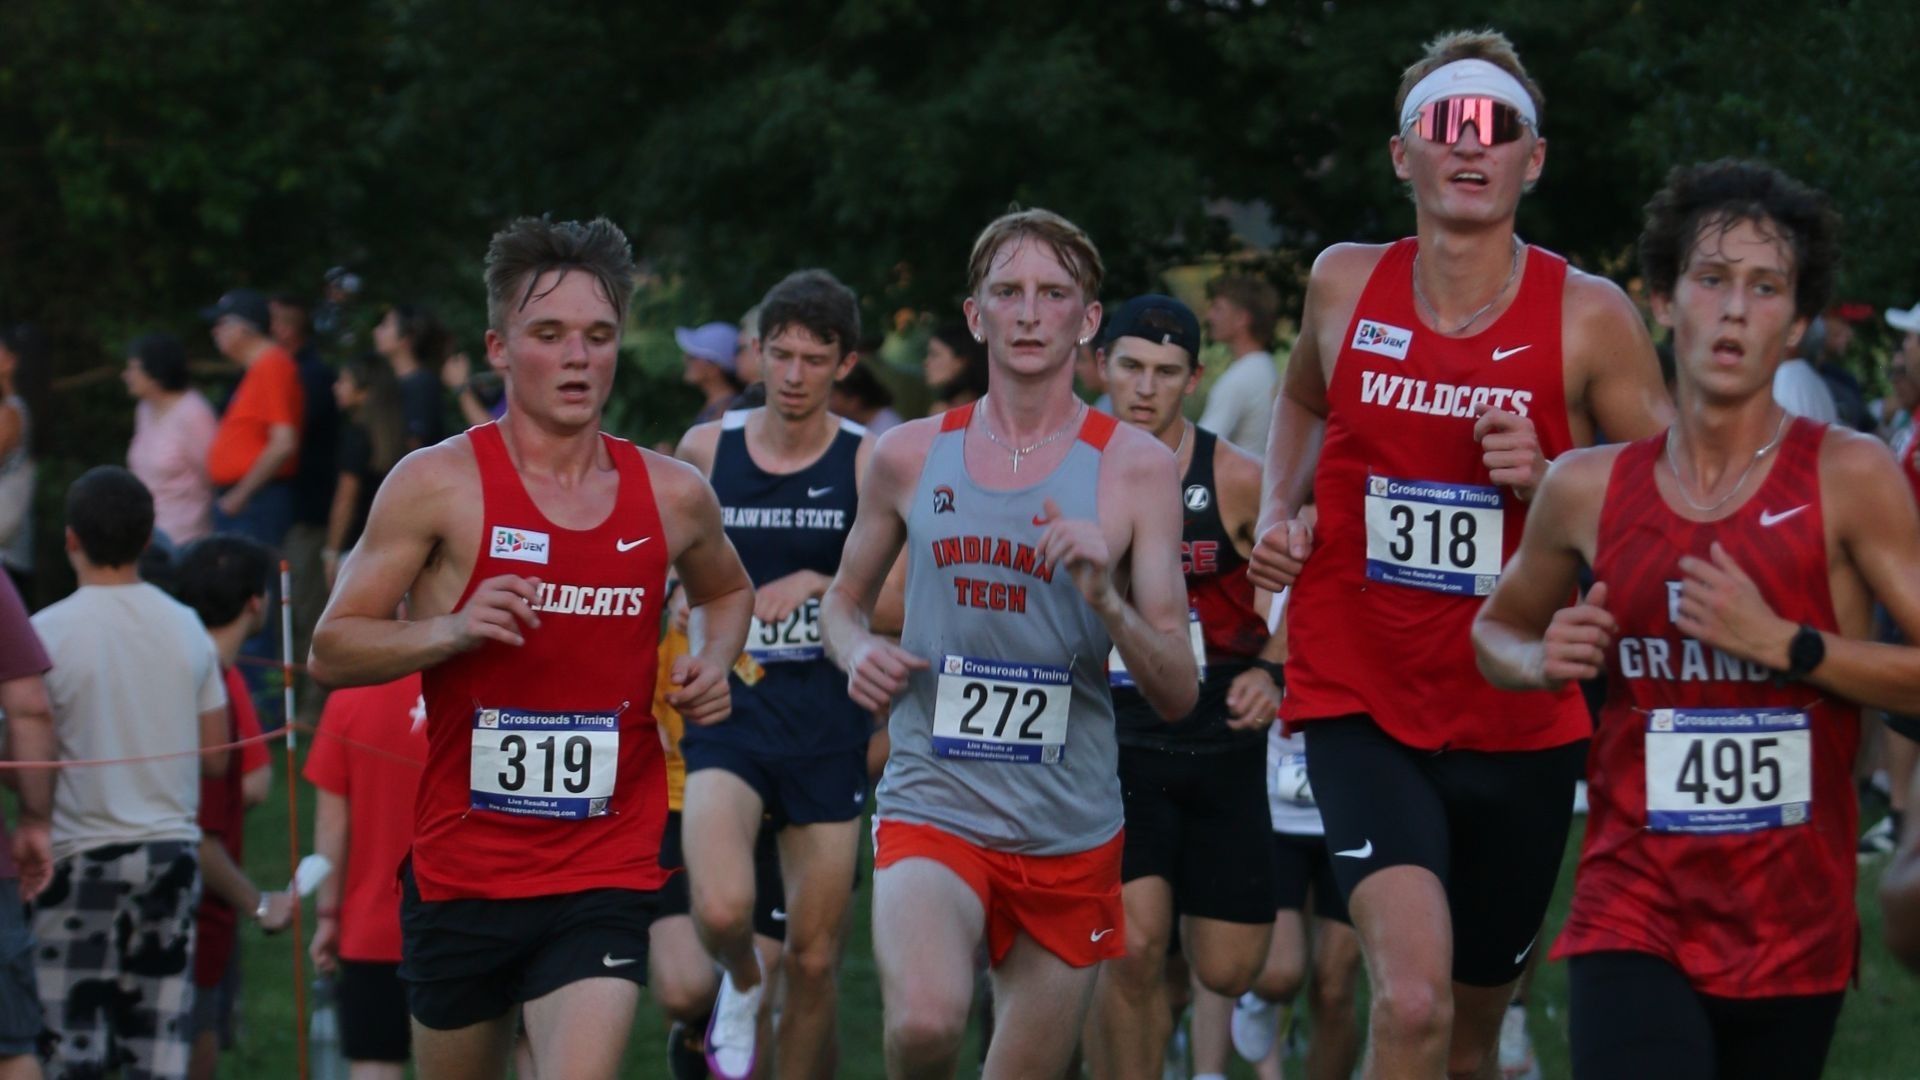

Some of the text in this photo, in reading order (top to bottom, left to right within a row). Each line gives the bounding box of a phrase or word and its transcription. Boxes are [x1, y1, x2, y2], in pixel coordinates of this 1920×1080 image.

[1361, 371, 1532, 418] WILDCATS
[1389, 483, 1499, 505] Crossroads Timing
[721, 507, 845, 530] HAWNEE STATE
[1389, 504, 1477, 569] 318
[523, 582, 645, 617] ILDCATS
[954, 576, 1027, 614] TECH
[964, 661, 1069, 683] Crossroads Timing
[500, 713, 615, 727] Crossroads Timing
[959, 682, 1048, 740] 272
[1674, 713, 1805, 726] Crossroads Timing
[498, 734, 592, 793] 319
[1676, 738, 1781, 804] 495
[507, 797, 522, 805] Live
[523, 799, 549, 807] Results
